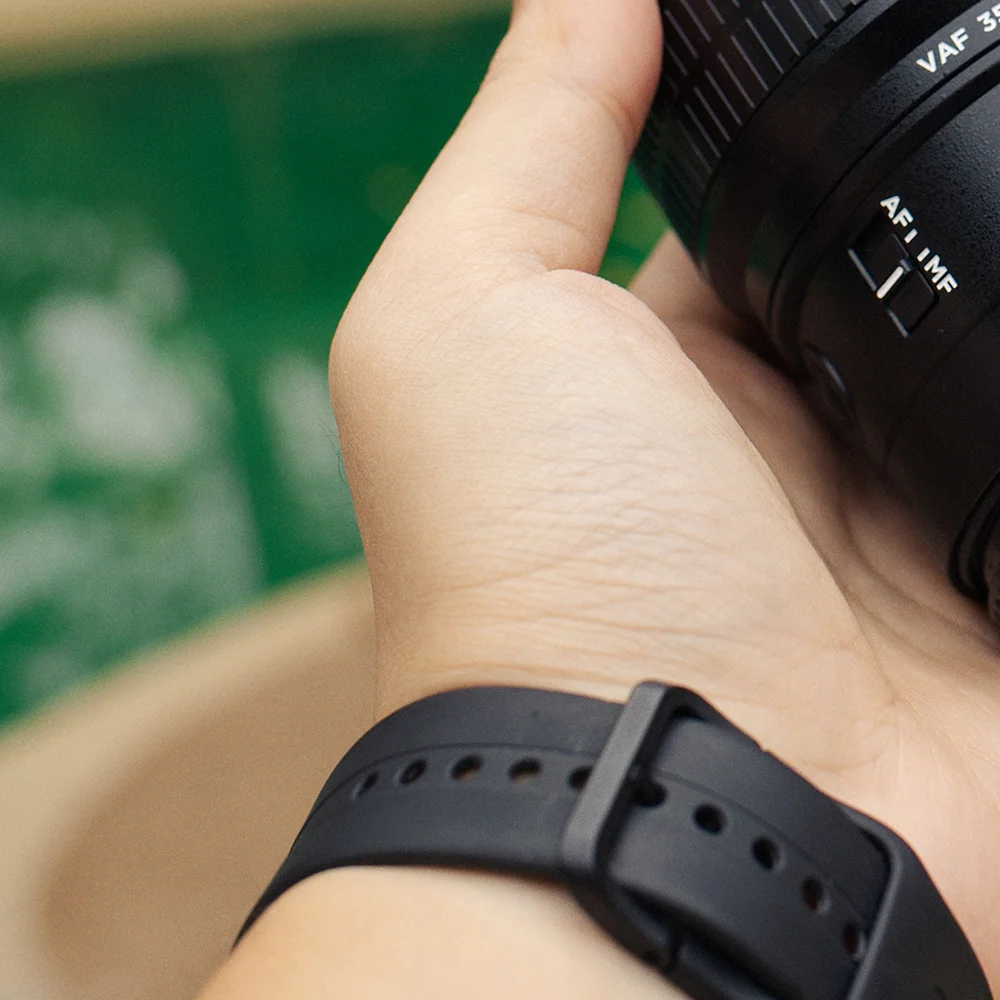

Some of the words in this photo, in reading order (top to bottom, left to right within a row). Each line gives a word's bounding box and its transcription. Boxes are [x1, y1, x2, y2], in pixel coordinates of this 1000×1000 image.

[915, 27, 970, 74] VAF
[880, 195, 914, 227] AF
[923, 254, 958, 293] MF
